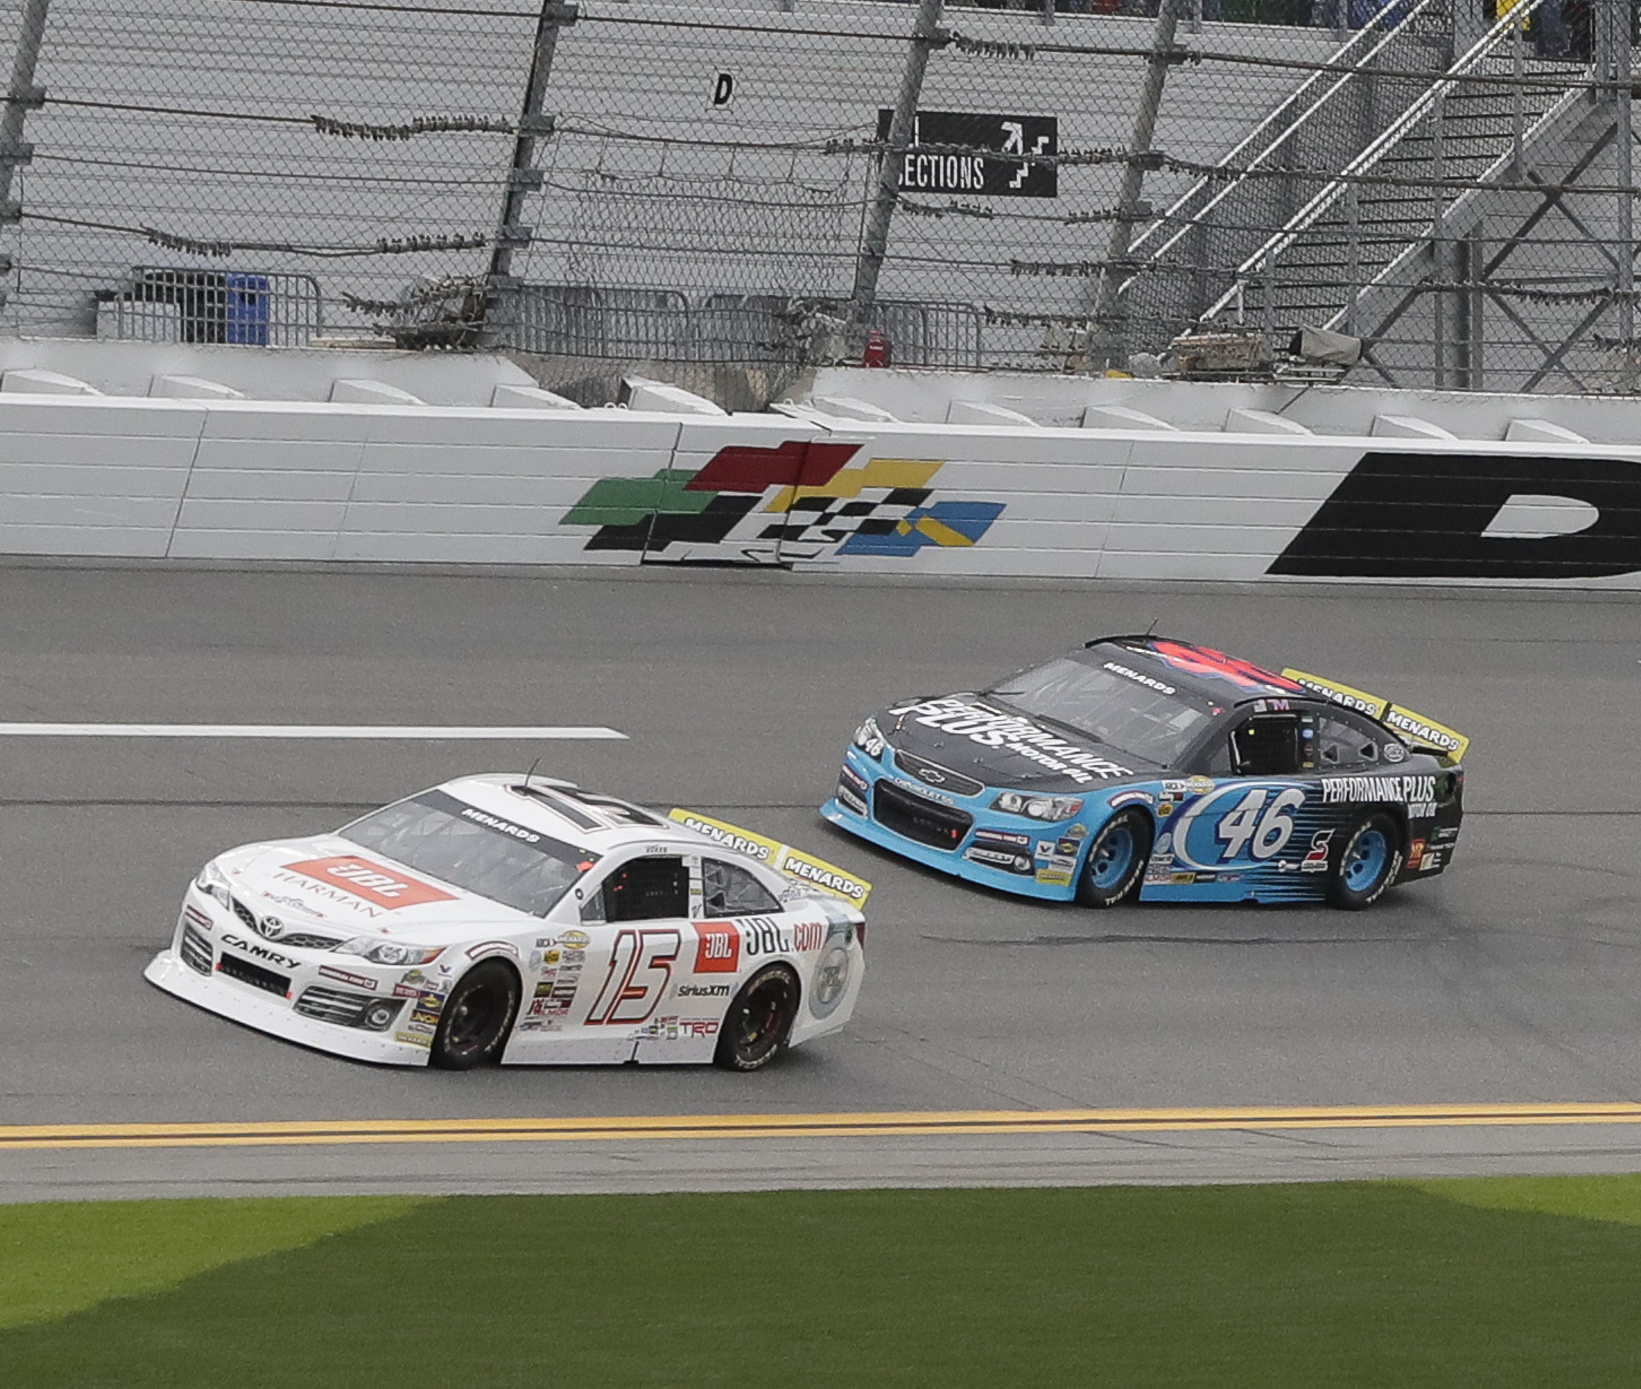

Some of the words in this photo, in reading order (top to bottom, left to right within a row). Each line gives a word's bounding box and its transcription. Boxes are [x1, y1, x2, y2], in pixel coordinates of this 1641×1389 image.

[714, 72, 733, 106] D
[1104, 662, 1175, 695] MENARDS
[1386, 710, 1460, 752] MENARDS
[1320, 778, 1403, 804] PERFORMANCE
[461, 808, 541, 843] MENARDS
[684, 817, 771, 861] MENARDS
[1218, 788, 1306, 860] 46
[273, 871, 382, 919] HARMAN
[326, 863, 409, 899] JBL
[784, 857, 865, 899] MENARDS
[220, 933, 302, 969] CAMRY
[705, 932, 734, 959] JBL
[737, 917, 823, 956] JBL.com
[583, 929, 682, 1026] 15
[677, 985, 731, 998] SiriusXM
